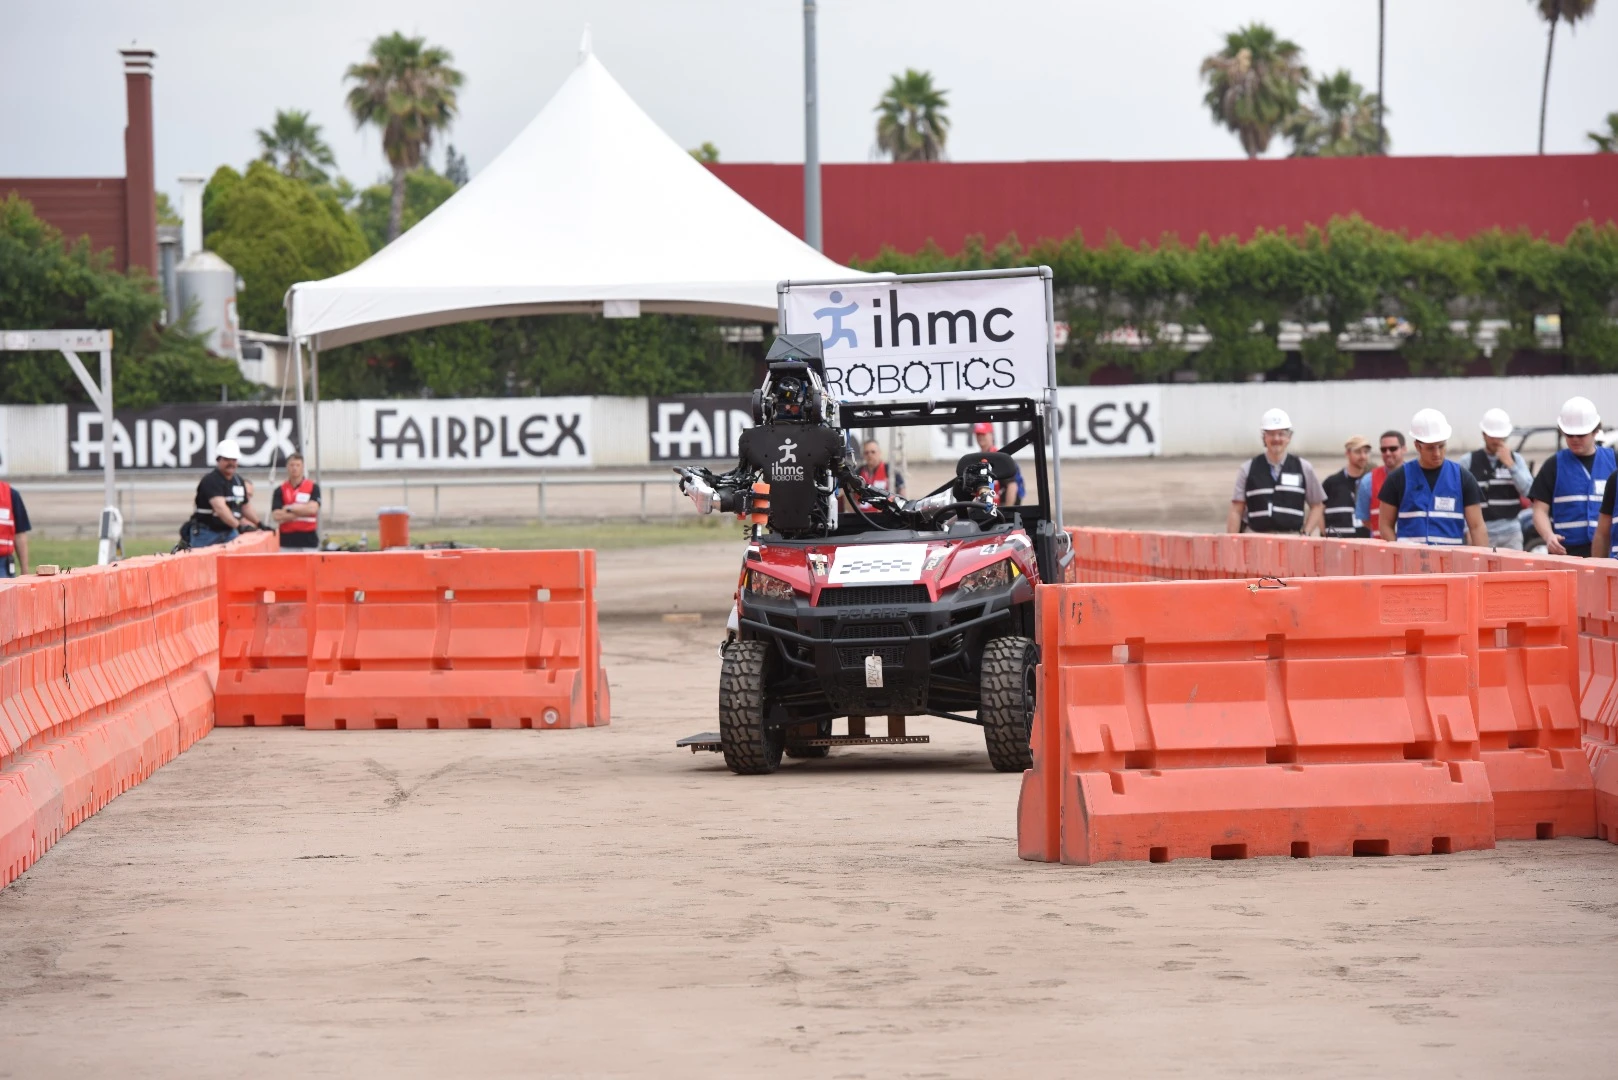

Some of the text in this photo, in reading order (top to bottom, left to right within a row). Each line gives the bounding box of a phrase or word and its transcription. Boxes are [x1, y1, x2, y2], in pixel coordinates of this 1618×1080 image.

[873, 290, 1014, 348] ihmc
[826, 357, 1015, 396] ROBOTICS
[71, 412, 297, 467] FAIRPLEX
[369, 409, 586, 459] FAIRPLEX
[772, 461, 804, 475] ihmc
[982, 544, 995, 554] 4
[837, 607, 909, 620] POLARIS
